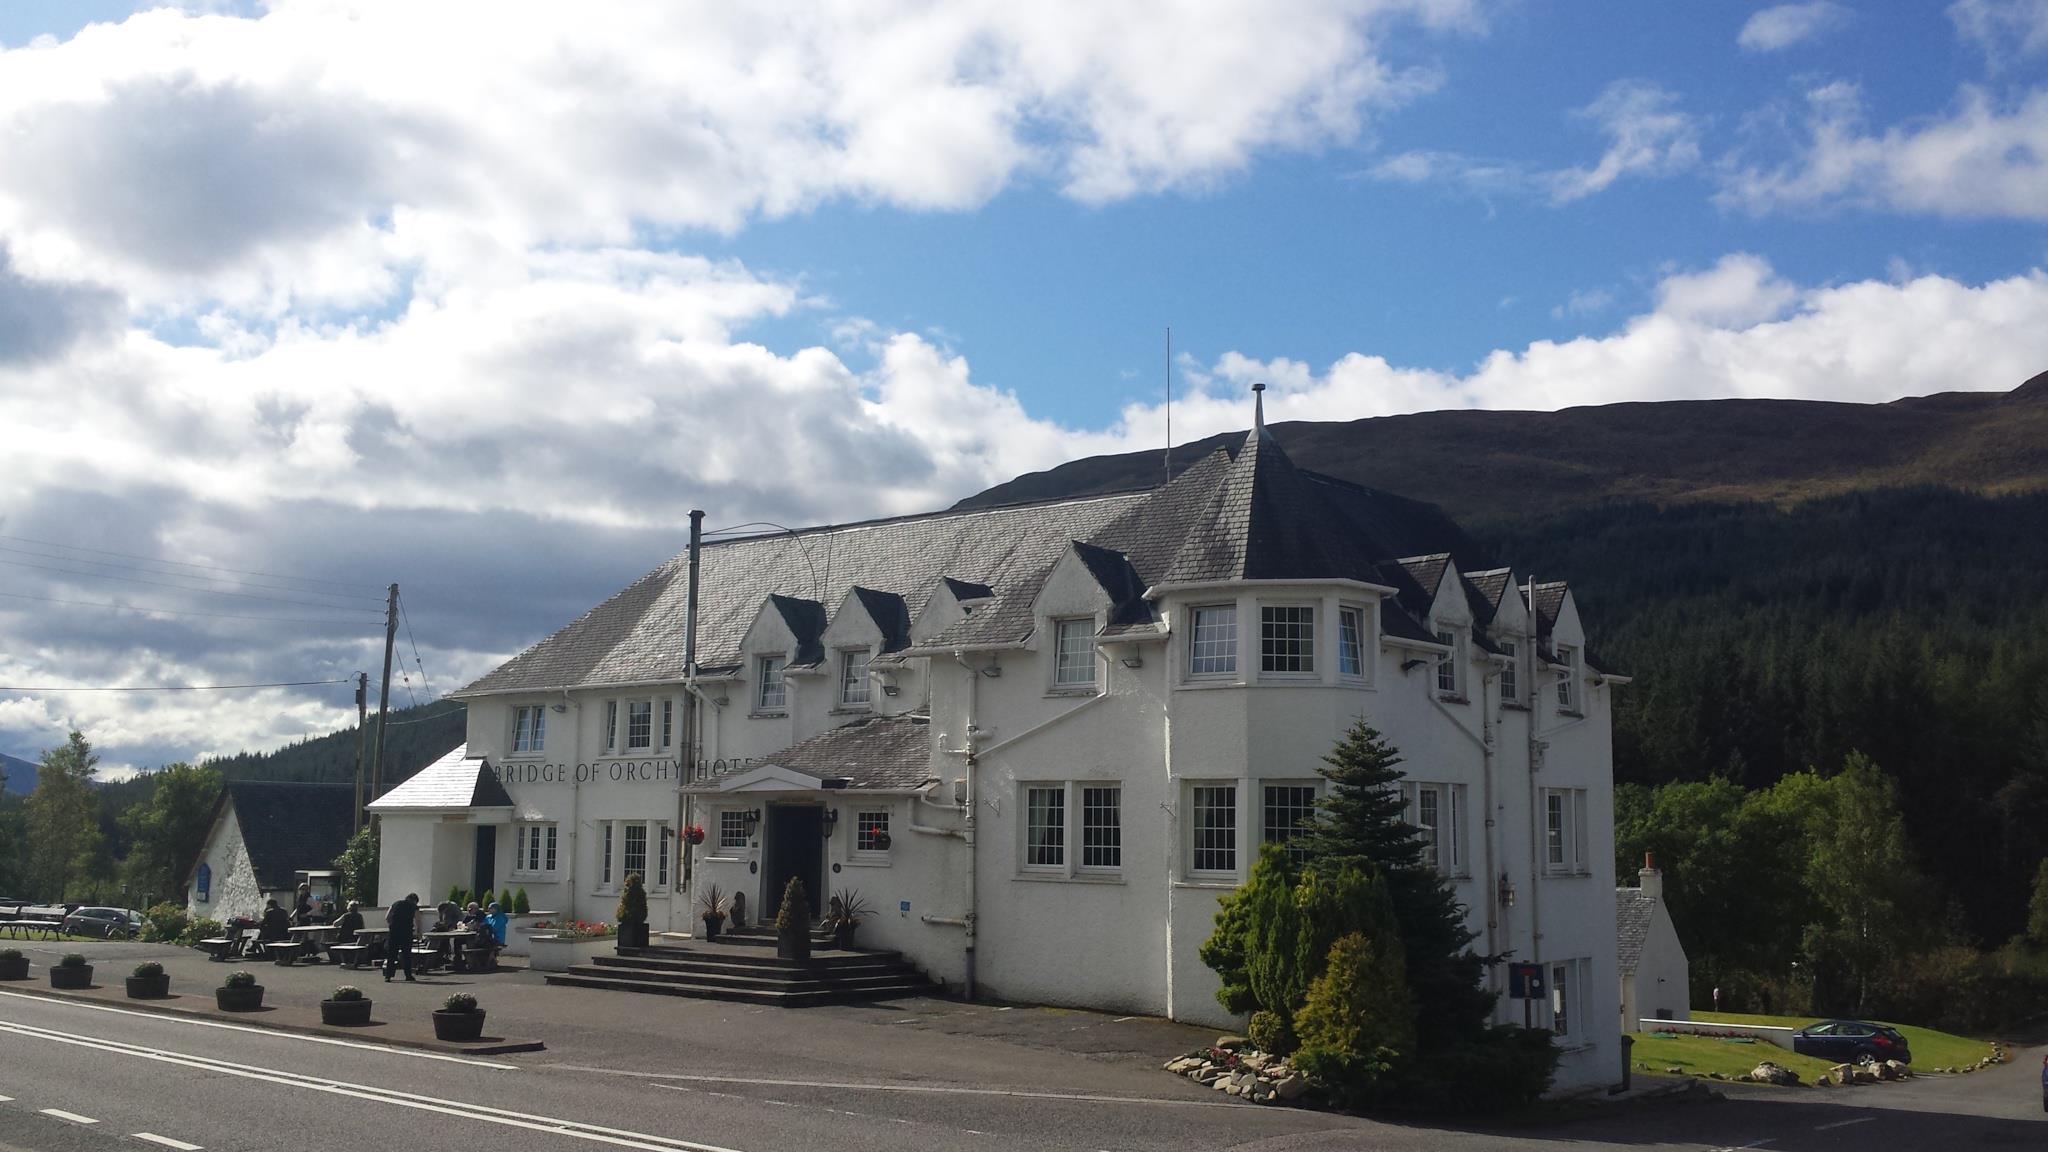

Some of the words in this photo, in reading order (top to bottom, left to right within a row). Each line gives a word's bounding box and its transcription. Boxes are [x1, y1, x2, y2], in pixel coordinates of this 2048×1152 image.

[494, 764, 565, 782] BRIDGE
[576, 763, 599, 782] OF
[610, 761, 680, 781] ORCHY
[697, 758, 752, 778] HOT
